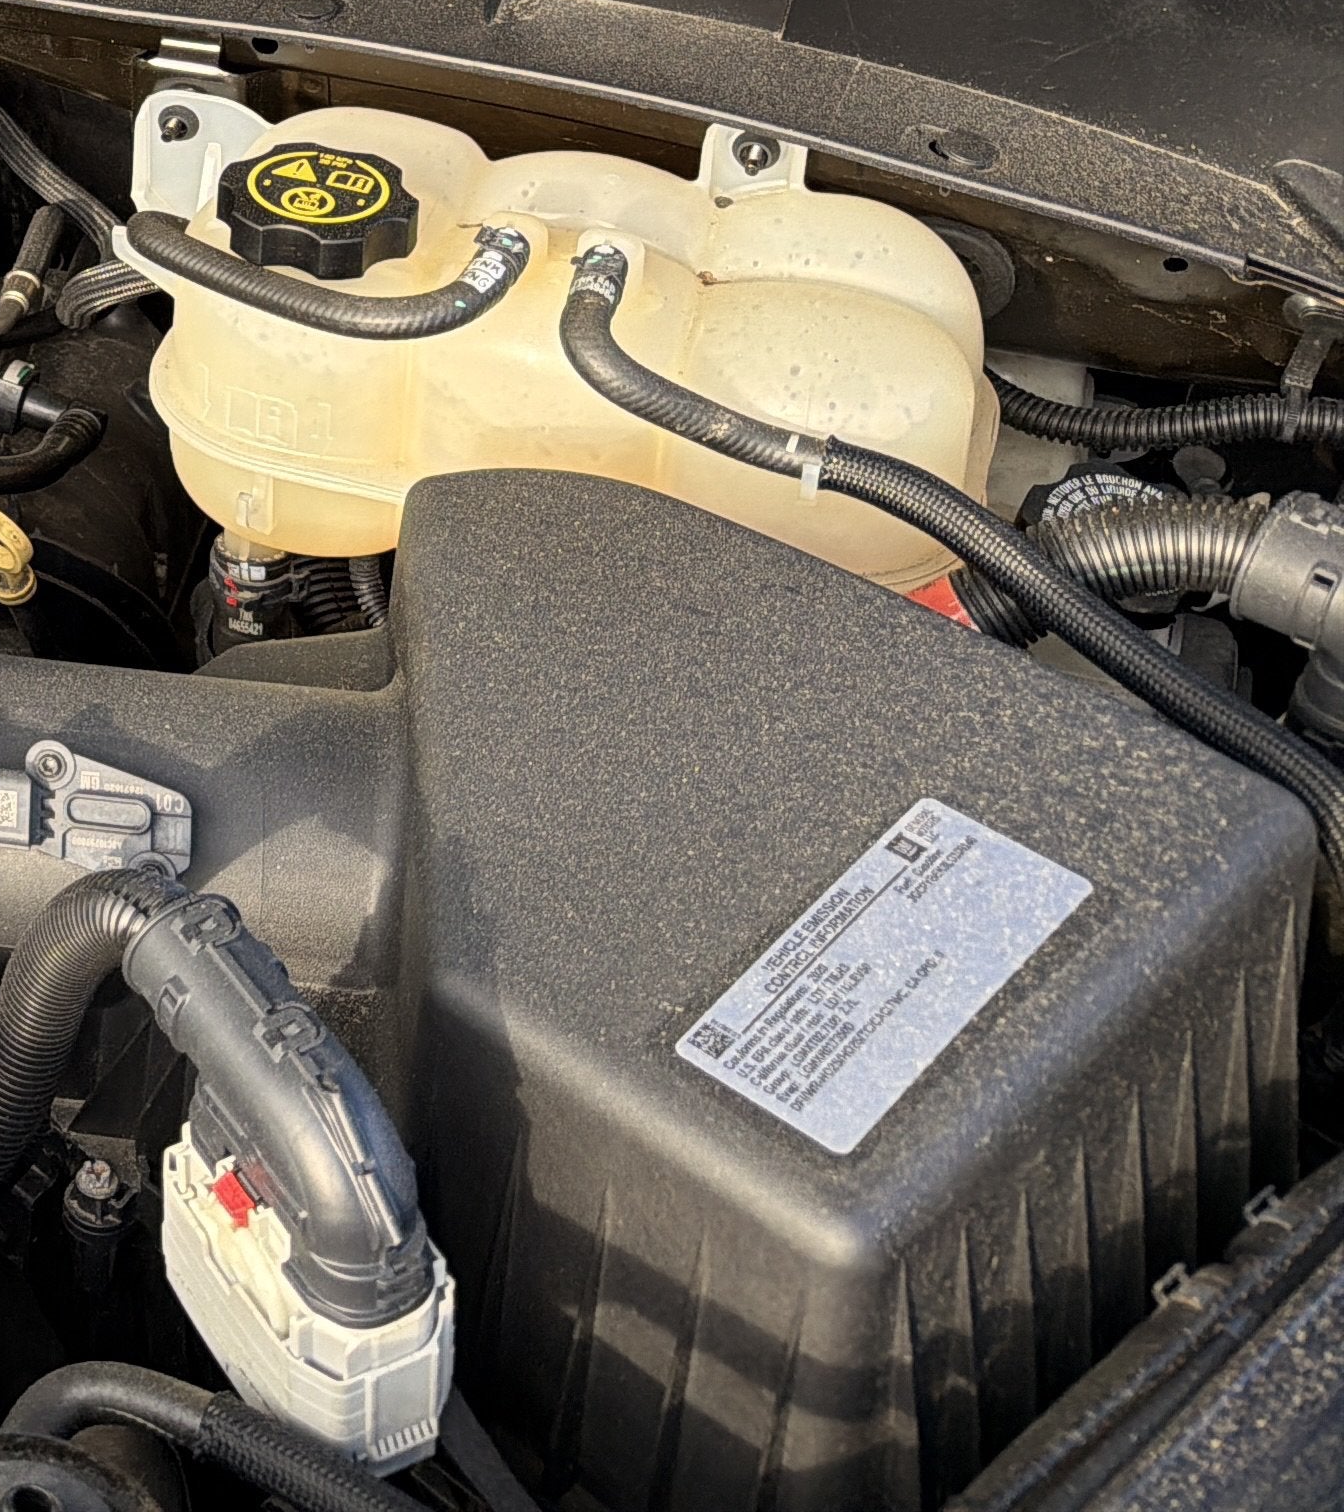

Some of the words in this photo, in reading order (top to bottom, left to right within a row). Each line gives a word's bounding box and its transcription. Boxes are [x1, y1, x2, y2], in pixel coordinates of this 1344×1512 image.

[1047, 478, 1082, 506] NETTOYER
[1081, 475, 1094, 486] LE
[1095, 474, 1142, 490] BOUCHON
[1068, 489, 1086, 504] QUE
[1085, 485, 1099, 496] DU
[80, 774, 100, 790] GM
[761, 930, 809, 974] VEHICLE
[800, 887, 852, 934] EMISSION
[763, 946, 816, 995] CONTROL
[808, 885, 875, 950] INFORMATION
